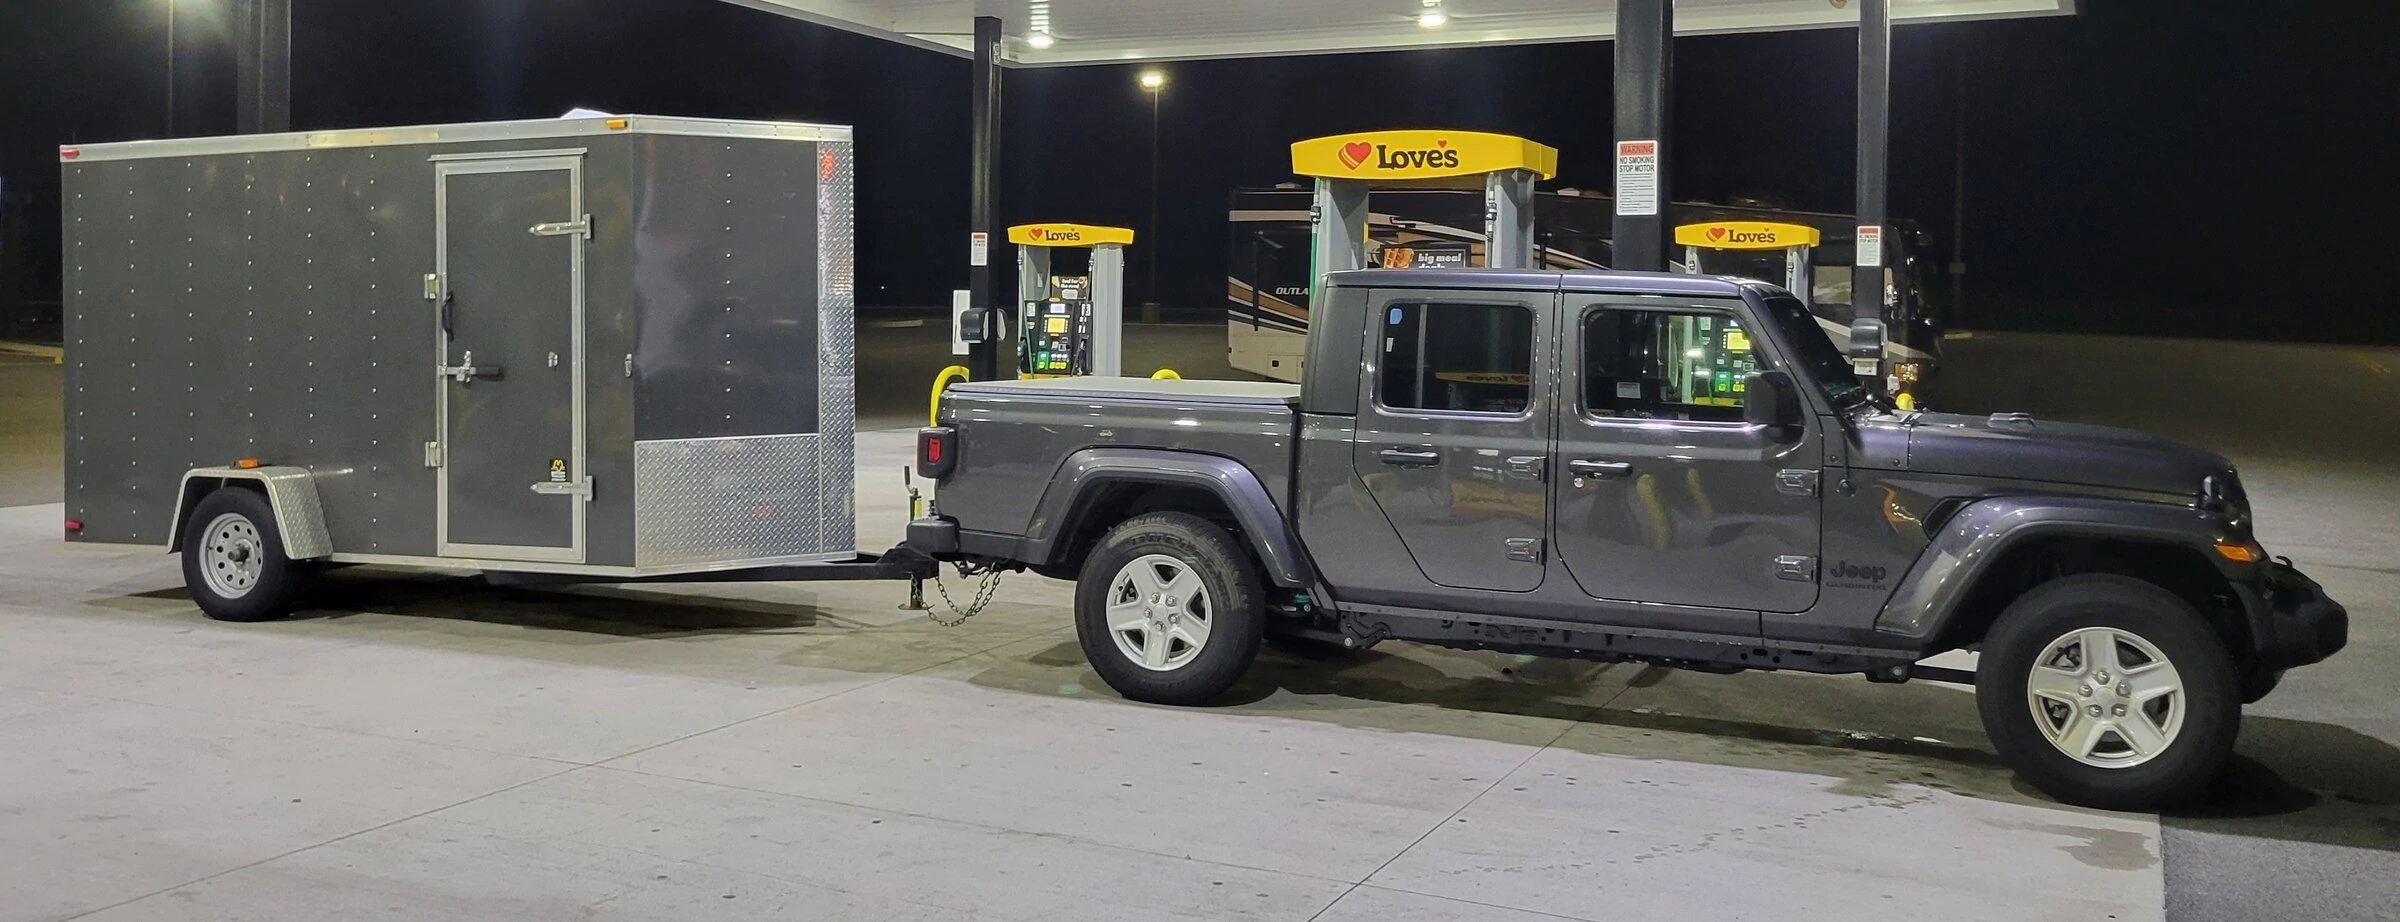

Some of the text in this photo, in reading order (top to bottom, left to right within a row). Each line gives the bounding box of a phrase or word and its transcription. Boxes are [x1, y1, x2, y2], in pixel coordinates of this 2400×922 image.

[1621, 145, 1654, 154] WARNING
[1628, 156, 1655, 164] SMOKING
[1619, 164, 1654, 173] STOP MOTOR
[1417, 253, 1462, 264] big meal
[1275, 287, 1309, 295] OUTLA
[1831, 560, 1886, 582] Jeep
